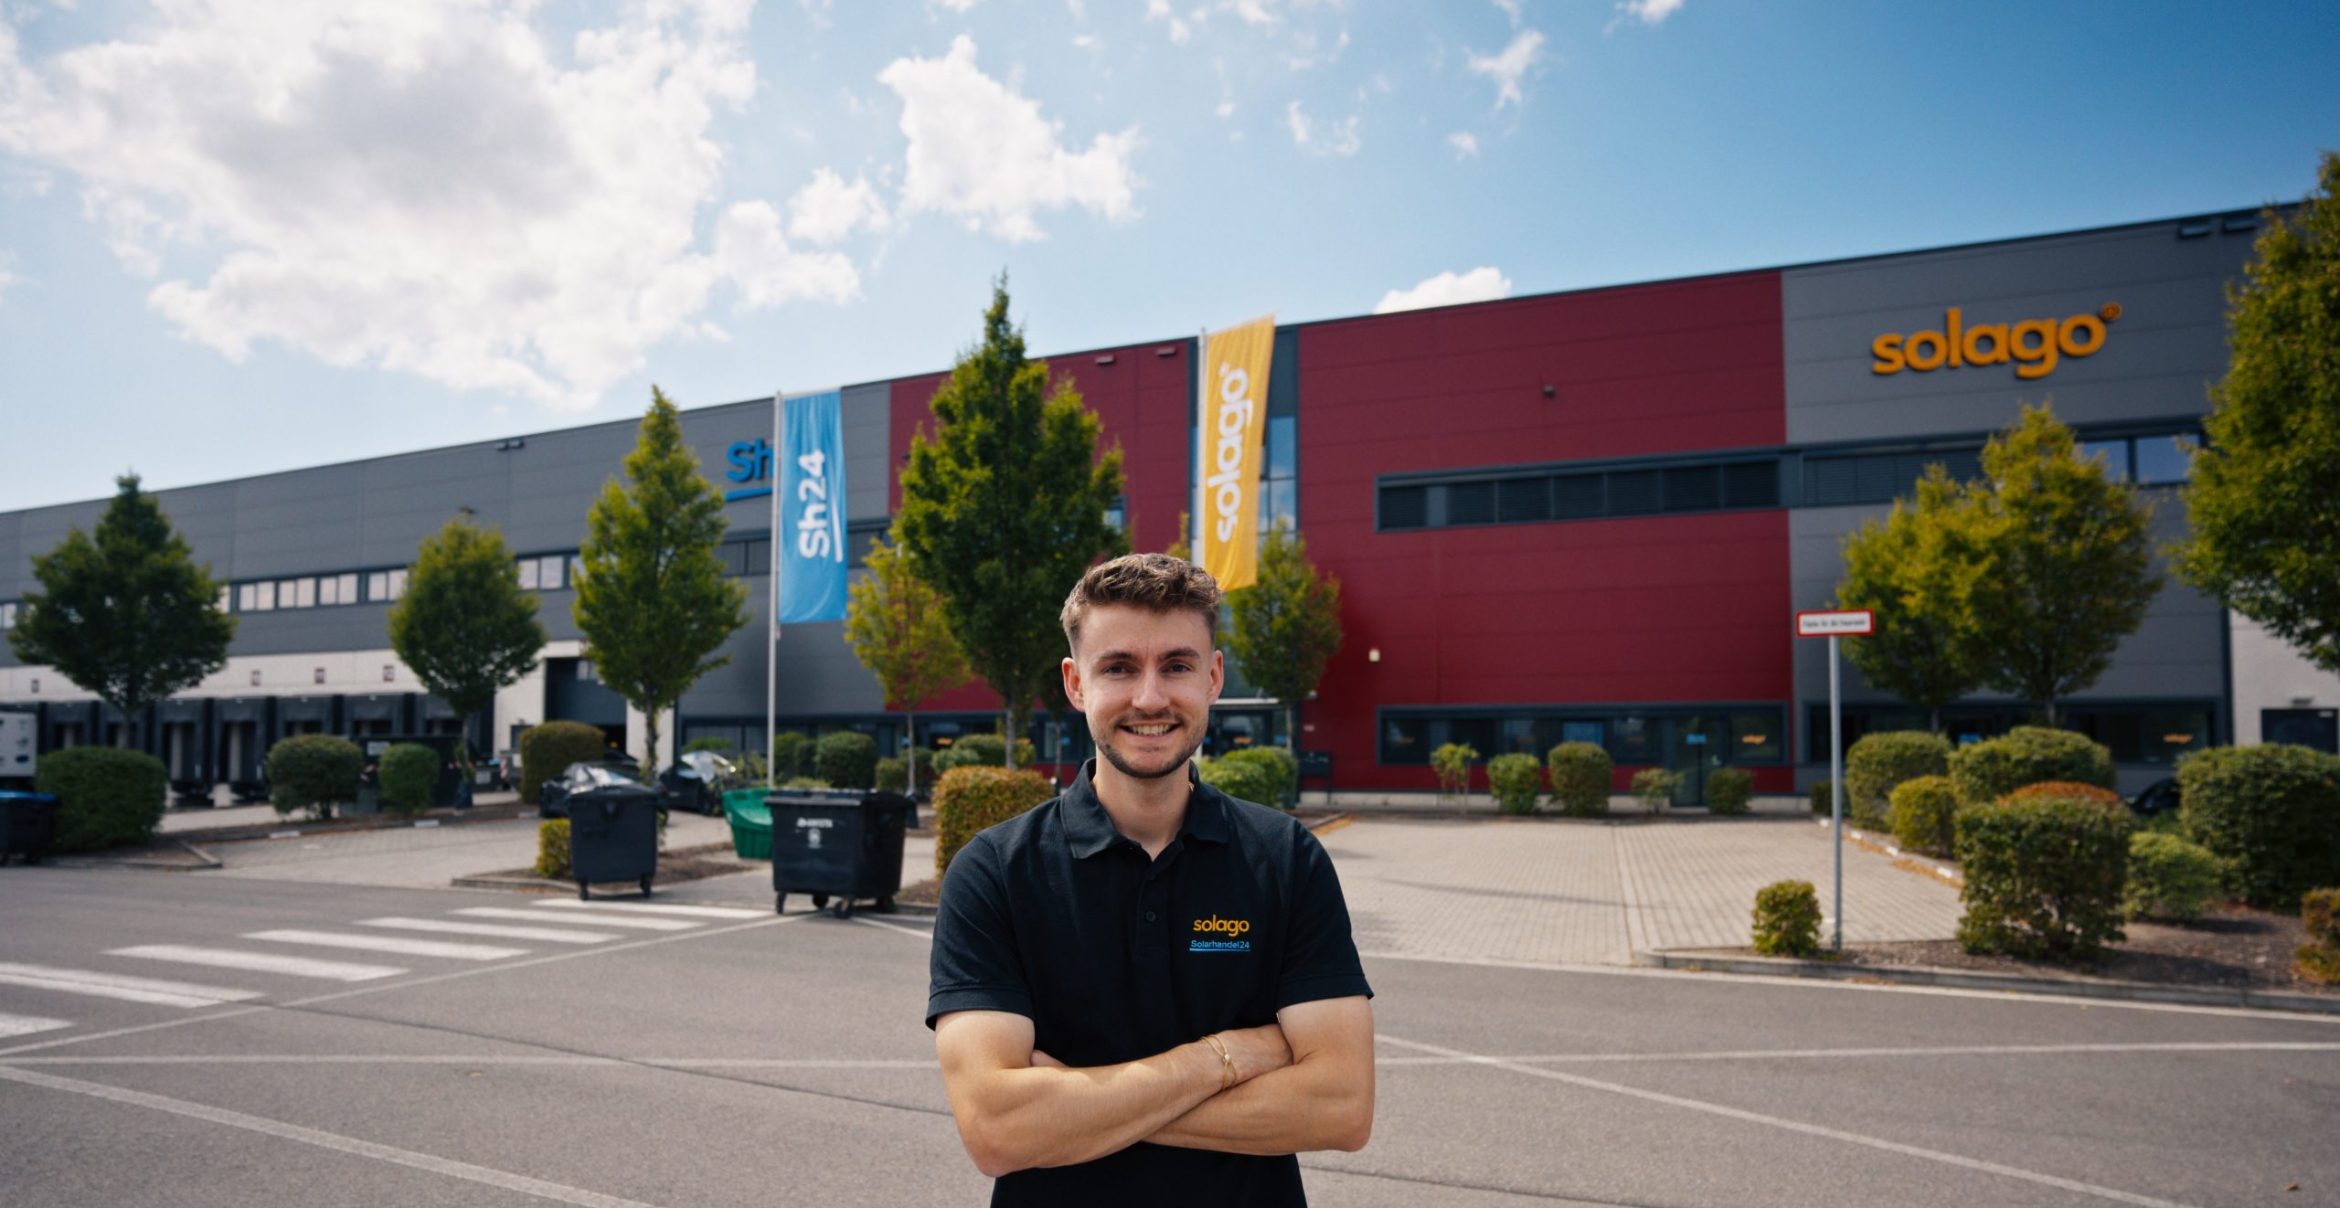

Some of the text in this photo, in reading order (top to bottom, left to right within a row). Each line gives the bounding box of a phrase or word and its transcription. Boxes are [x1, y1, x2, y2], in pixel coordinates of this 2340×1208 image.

[1872, 307, 2107, 378] solago
[1207, 367, 1254, 542] solago
[798, 448, 830, 559] Sh24
[1191, 940, 1250, 949] Solarhandel24
[1193, 913, 1250, 937] solago
